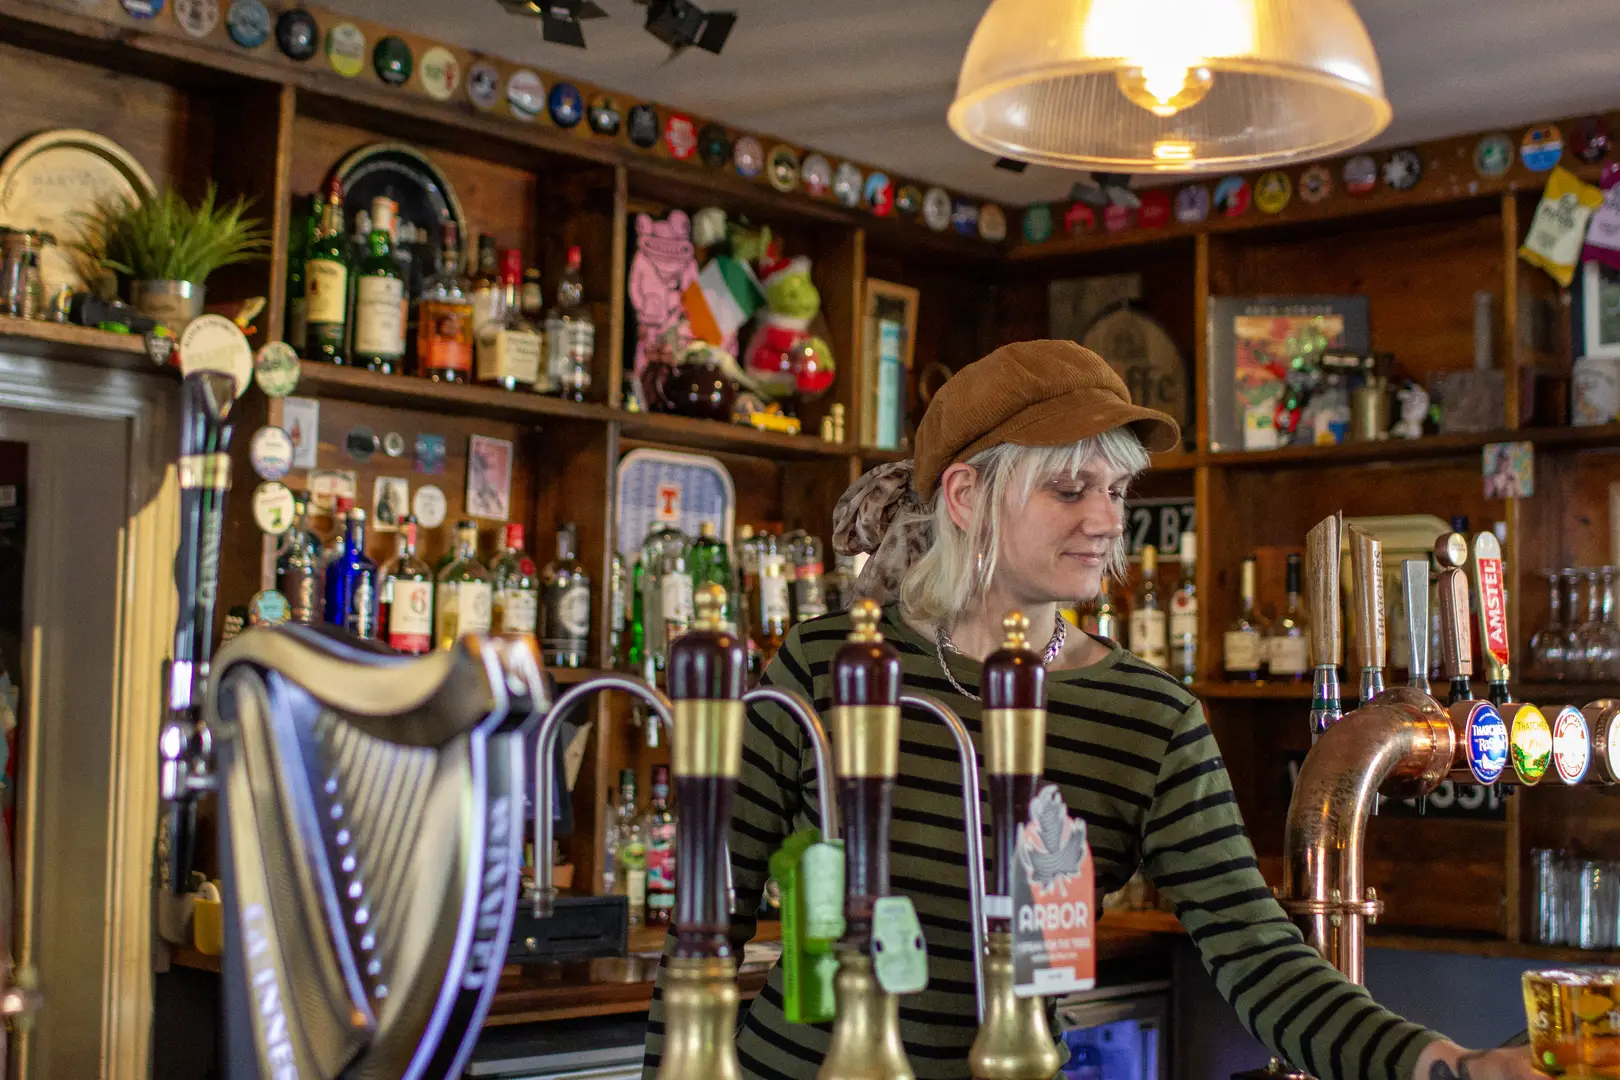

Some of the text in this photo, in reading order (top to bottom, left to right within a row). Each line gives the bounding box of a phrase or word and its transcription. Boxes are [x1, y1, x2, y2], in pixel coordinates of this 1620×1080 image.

[662, 489, 677, 514] T
[1374, 549, 1386, 640] THATCHERS
[1484, 560, 1504, 644] AMSTEL
[1019, 901, 1088, 931] ARBOR
